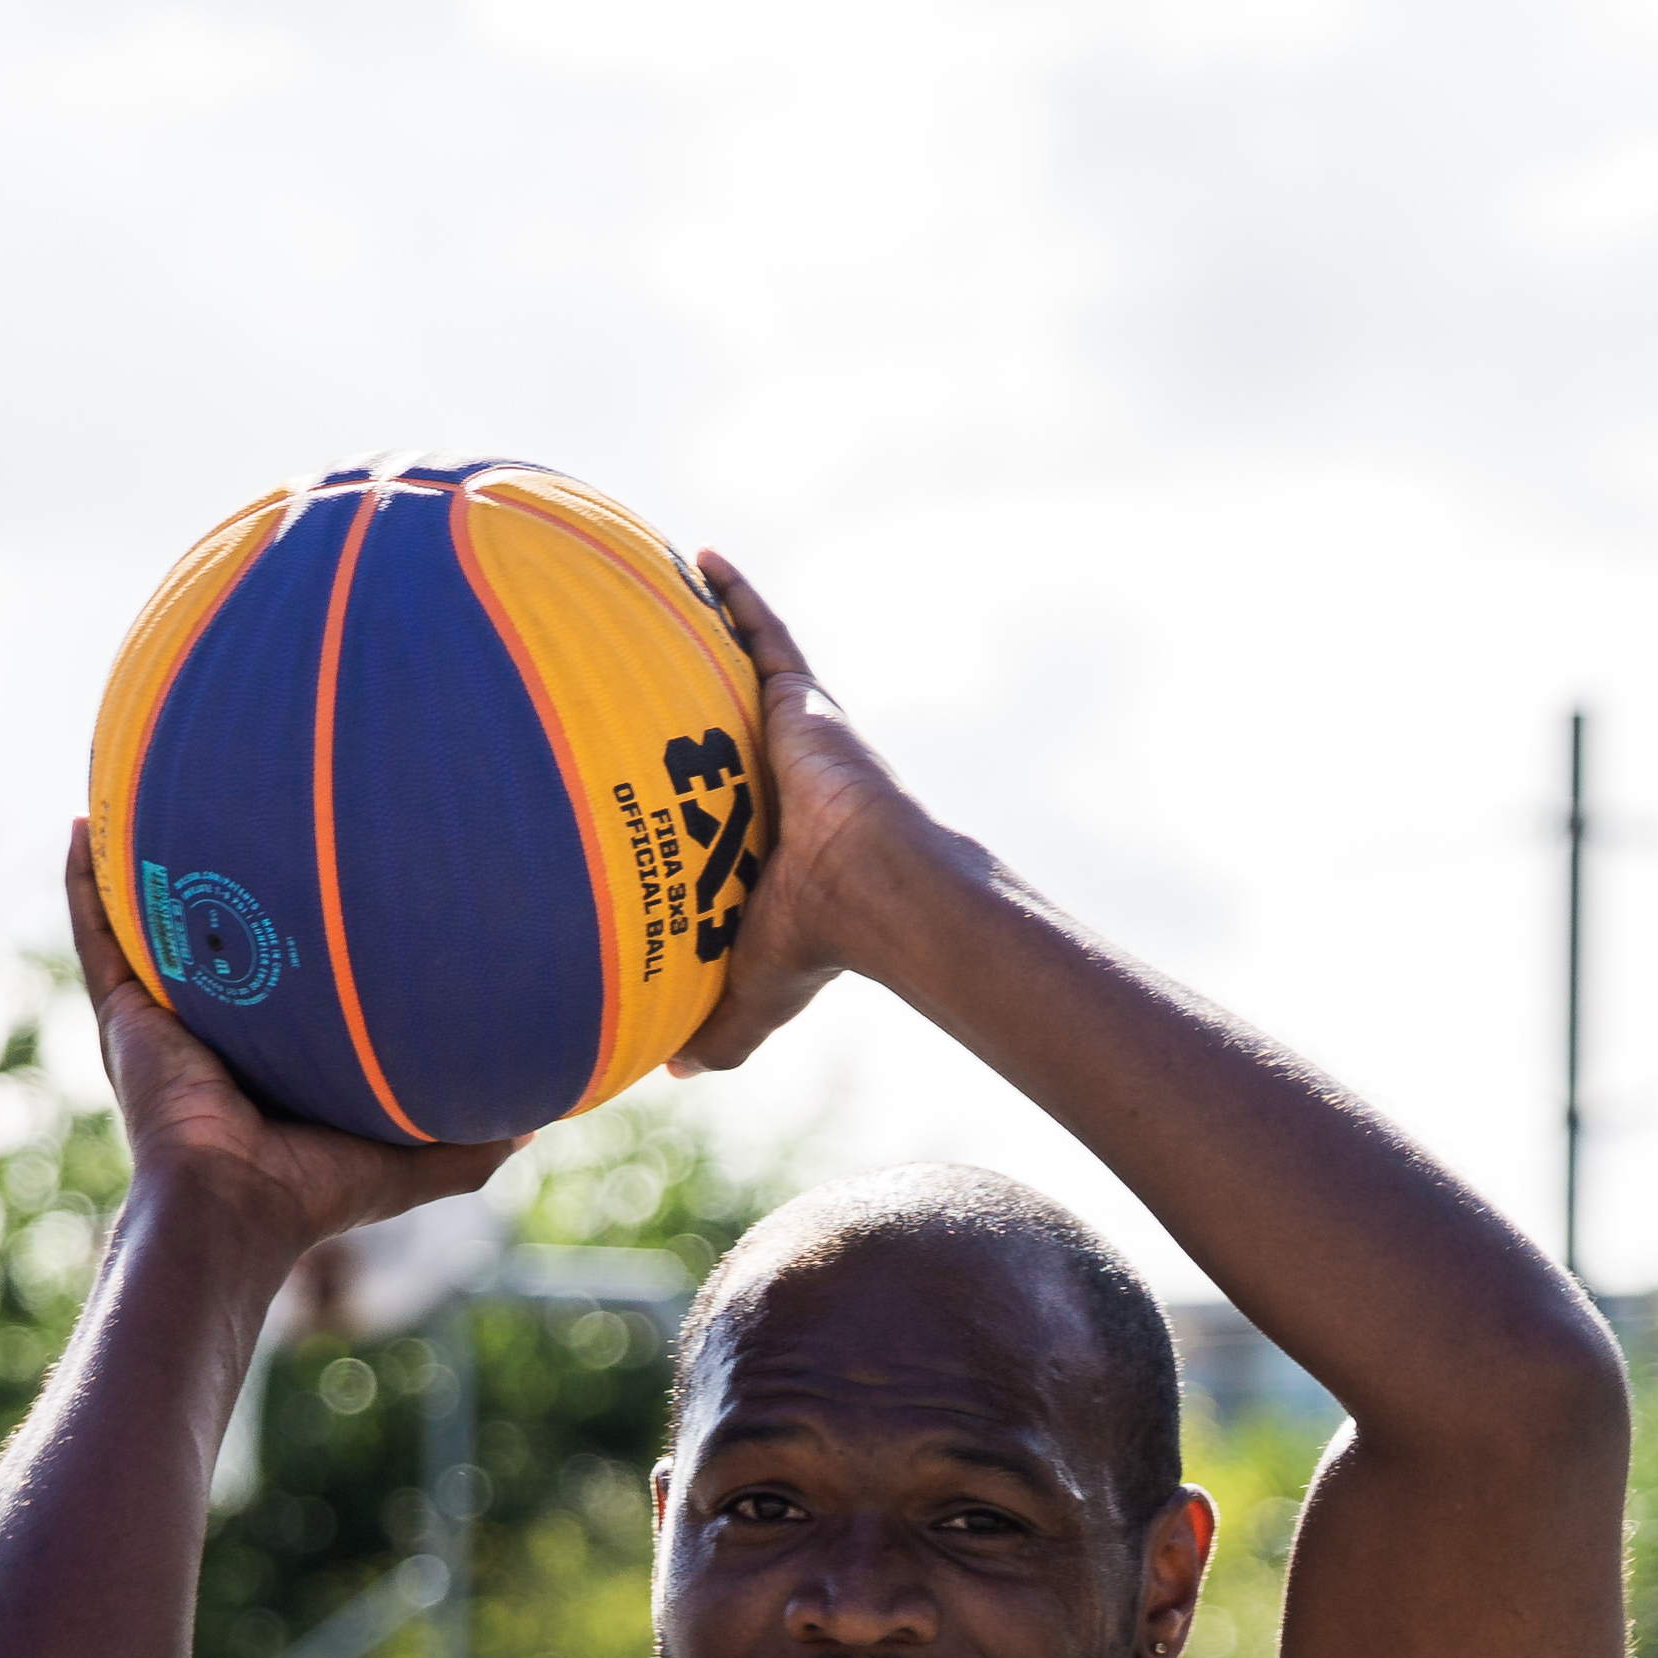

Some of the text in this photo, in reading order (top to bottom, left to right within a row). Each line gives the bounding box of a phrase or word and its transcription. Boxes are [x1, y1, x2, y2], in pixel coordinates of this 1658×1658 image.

[612, 782, 666, 983] OFFICIAL BALL
[650, 807, 684, 879] FIBA
